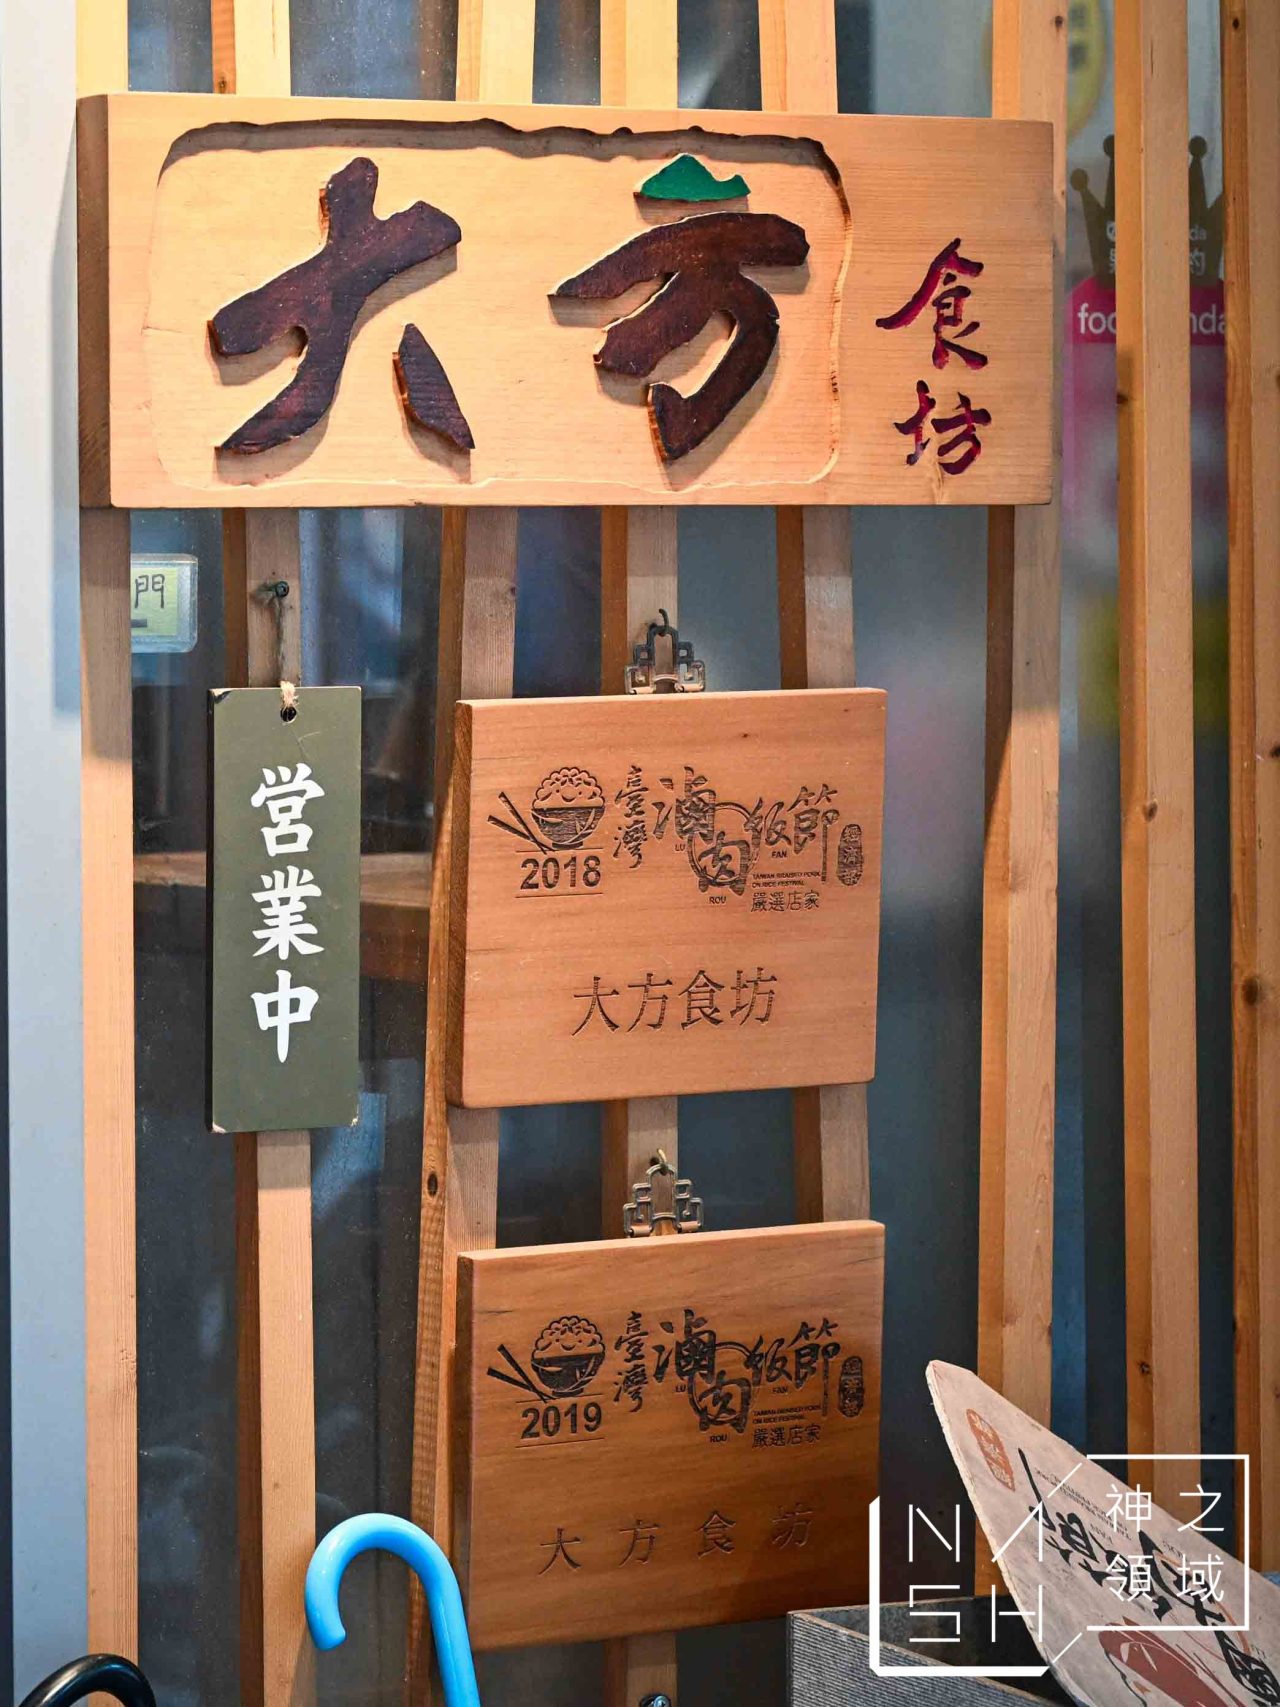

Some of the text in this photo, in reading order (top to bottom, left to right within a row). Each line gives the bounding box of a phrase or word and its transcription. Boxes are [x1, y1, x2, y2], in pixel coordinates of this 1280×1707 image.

[207, 153, 810, 462] 大方
[876, 237, 992, 477] 食坊
[612, 765, 649, 869] 臺灣
[520, 855, 602, 890] 2018
[708, 896, 727, 905] ROU
[250, 762, 325, 1063] 営業中
[571, 966, 778, 1037] 大方食坊
[612, 1311, 650, 1414] 臺灣
[520, 1402, 603, 1440] 2019
[709, 1434, 728, 1443] ROU
[538, 1503, 813, 1576] 大方食坊
